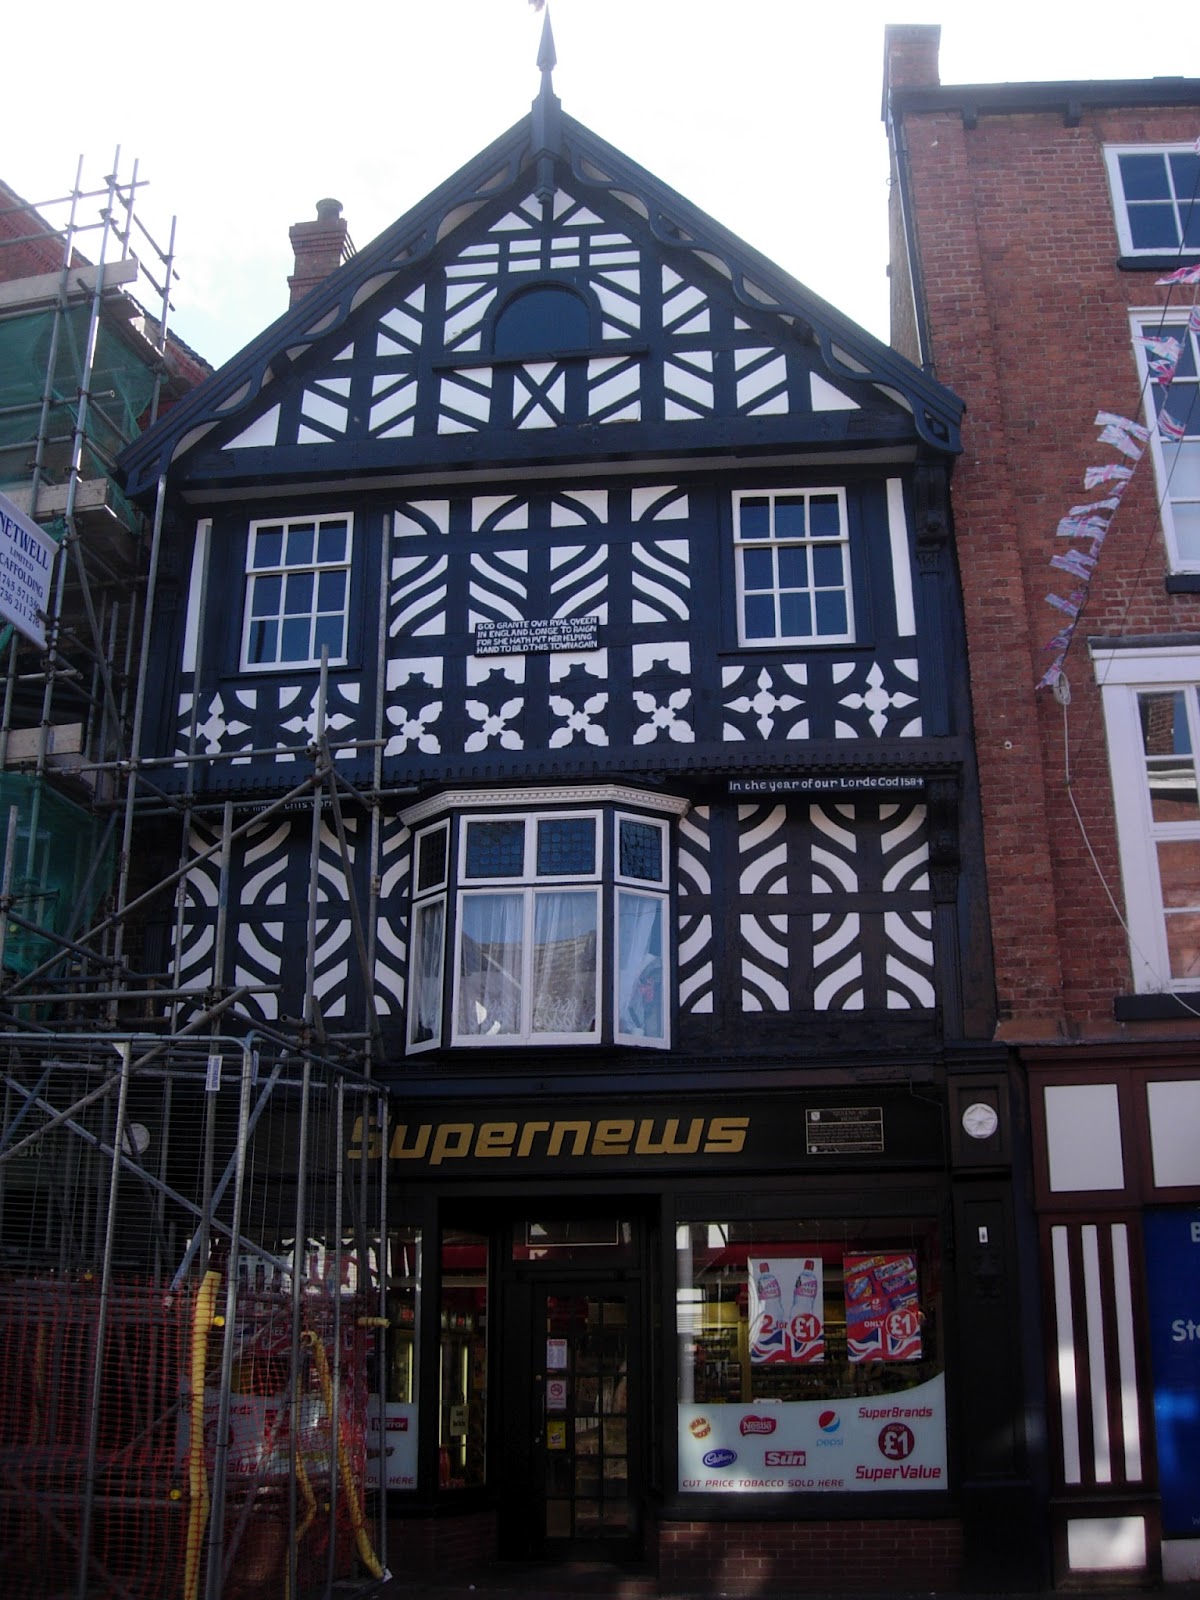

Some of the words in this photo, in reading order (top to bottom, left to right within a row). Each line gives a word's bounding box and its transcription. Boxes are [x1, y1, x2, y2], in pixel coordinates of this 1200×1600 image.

[10, 547, 34, 572] LIMITED
[497, 621, 529, 629] GRANTE
[531, 619, 548, 627] OVR
[550, 618, 569, 626] RYAL
[570, 617, 597, 626] QVEEN
[489, 628, 529, 637] ENGLAND
[530, 627, 558, 635] LONGE
[573, 624, 597, 633] RAIGN
[493, 637, 508, 645] SHE
[510, 636, 531, 644] HATH
[532, 635, 547, 643] PVT
[548, 634, 563, 642] HER
[476, 646, 500, 654] HAND
[529, 643, 549, 651] THIS
[729, 781, 741, 790] In
[745, 779, 767, 789] the
[769, 781, 799, 792] year
[801, 778, 814, 788] of
[814, 779, 838, 788] our
[840, 777, 877, 788] Lorde
[900, 777, 924, 786] 1584
[347, 1114, 751, 1166] Supernews
[760, 1314, 773, 1333] 2
[795, 1317, 815, 1338] £1
[864, 1320, 885, 1328] ONLY
[890, 1313, 911, 1335] £1
[858, 1406, 933, 1420] SuperBrands
[816, 1438, 844, 1447] pepsi
[884, 1430, 909, 1455] £1
[766, 1452, 804, 1466] Sun
[389, 1476, 414, 1484] HERE
[856, 1465, 941, 1482] SuperValue
[682, 1479, 702, 1487] CUT
[705, 1479, 734, 1487] PRICE
[738, 1479, 784, 1487] TOBACCO
[787, 1479, 814, 1487] SOLD
[817, 1479, 844, 1487] HERE
